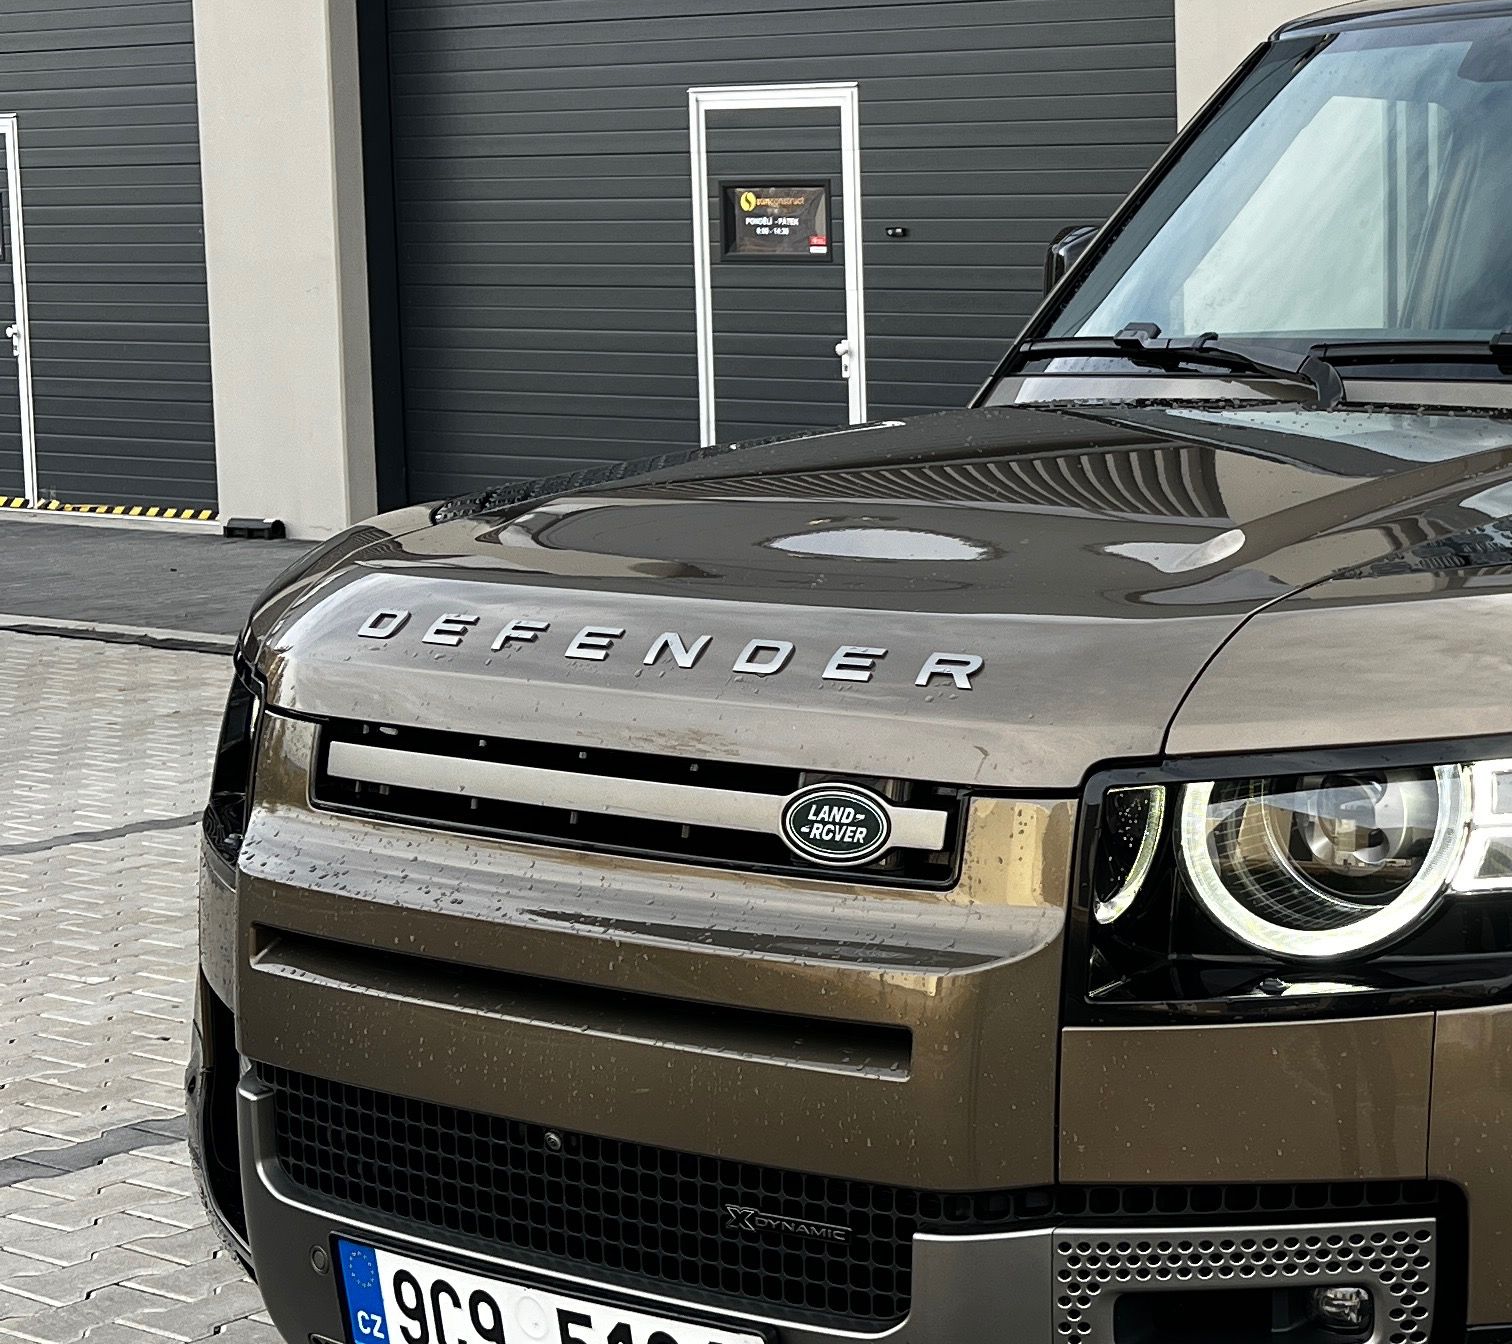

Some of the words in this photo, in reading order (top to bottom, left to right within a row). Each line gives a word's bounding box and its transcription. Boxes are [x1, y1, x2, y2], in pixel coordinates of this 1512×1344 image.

[357, 608, 985, 691] DEFENDER
[807, 804, 855, 824] LAND
[808, 822, 868, 844] ROVER
[754, 1216, 847, 1242] DYNAMIC
[357, 1309, 385, 1340] CZ
